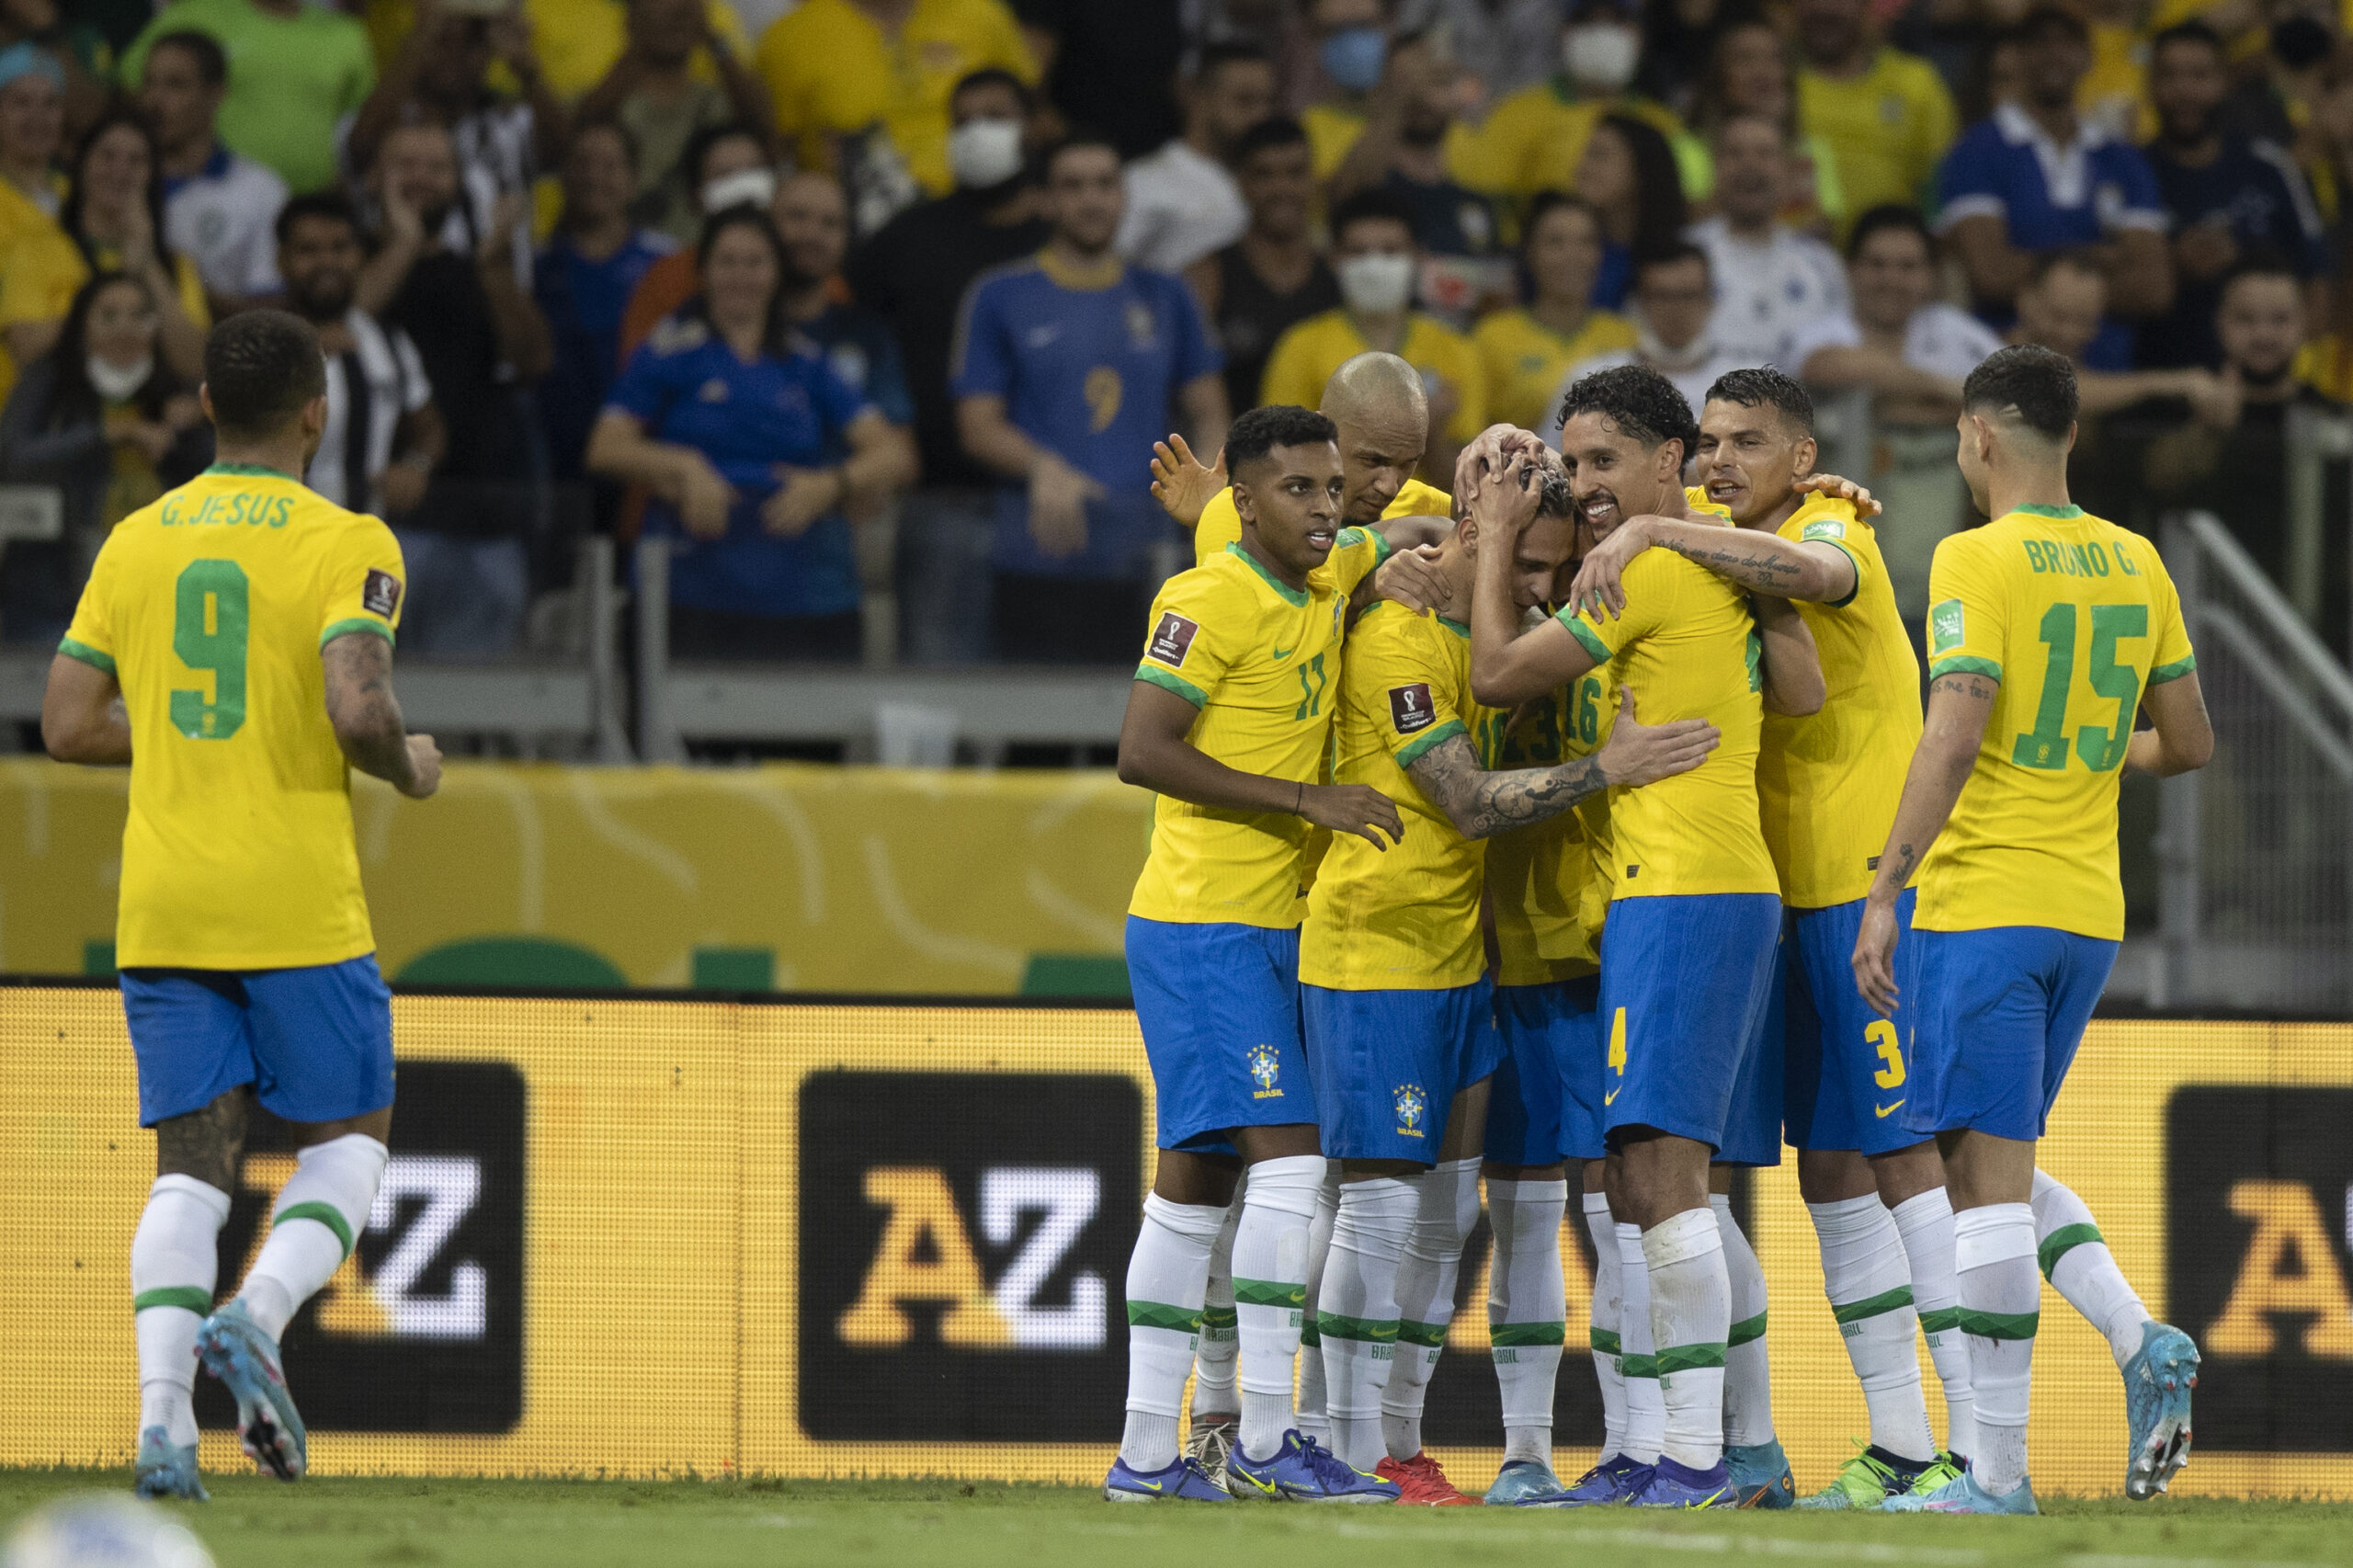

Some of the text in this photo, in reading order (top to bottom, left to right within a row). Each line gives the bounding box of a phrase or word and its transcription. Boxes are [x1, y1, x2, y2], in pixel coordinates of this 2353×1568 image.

[2022, 540, 2143, 577] BRUNO G.
[169, 558, 249, 740] 9
[2011, 602, 2148, 772] 15
[1608, 1007, 1627, 1076] 4
[1864, 1018, 1906, 1089] 3
[1253, 1088, 1284, 1100] BRASIL
[1397, 1127, 1425, 1139] BRASIL
[835, 1165, 1107, 1348] AZ
[2202, 1178, 2353, 1358] A
